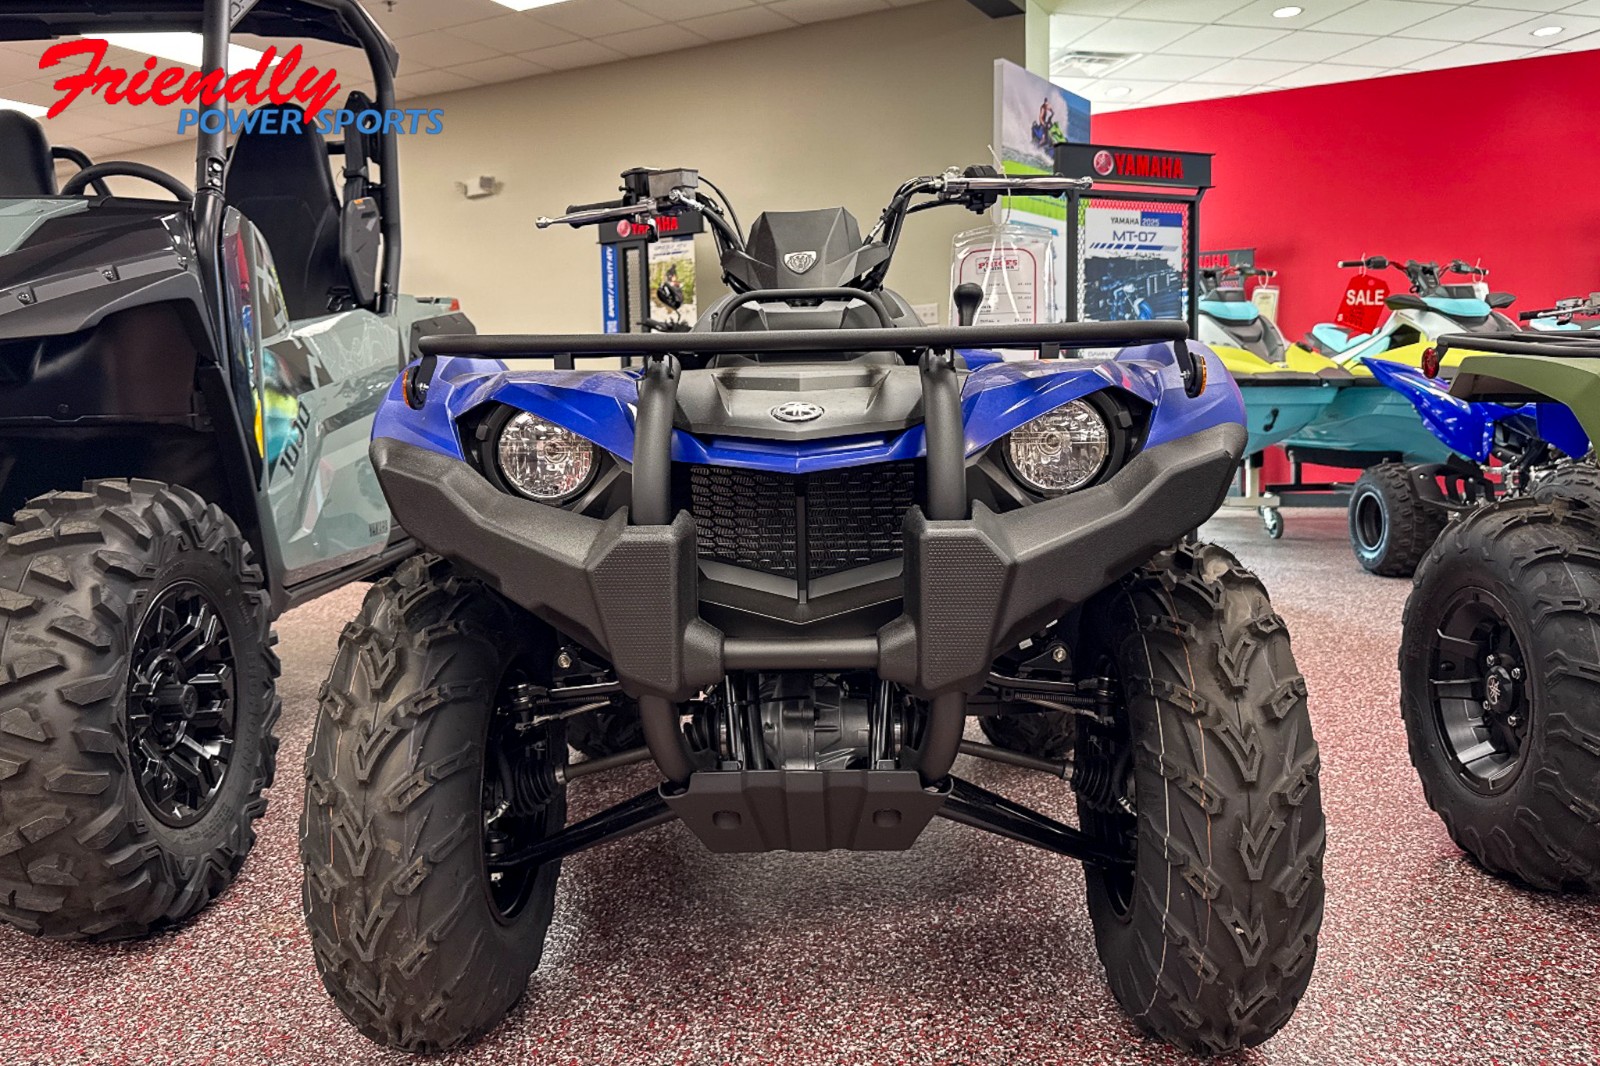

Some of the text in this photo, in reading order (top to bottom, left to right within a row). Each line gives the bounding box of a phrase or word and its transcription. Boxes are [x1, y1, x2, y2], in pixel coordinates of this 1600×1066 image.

[1114, 152, 1184, 179] YAMAHA
[1111, 216, 1139, 225] YAMAHA
[1112, 230, 1157, 243] MT-07
[1346, 289, 1385, 306] SALE
